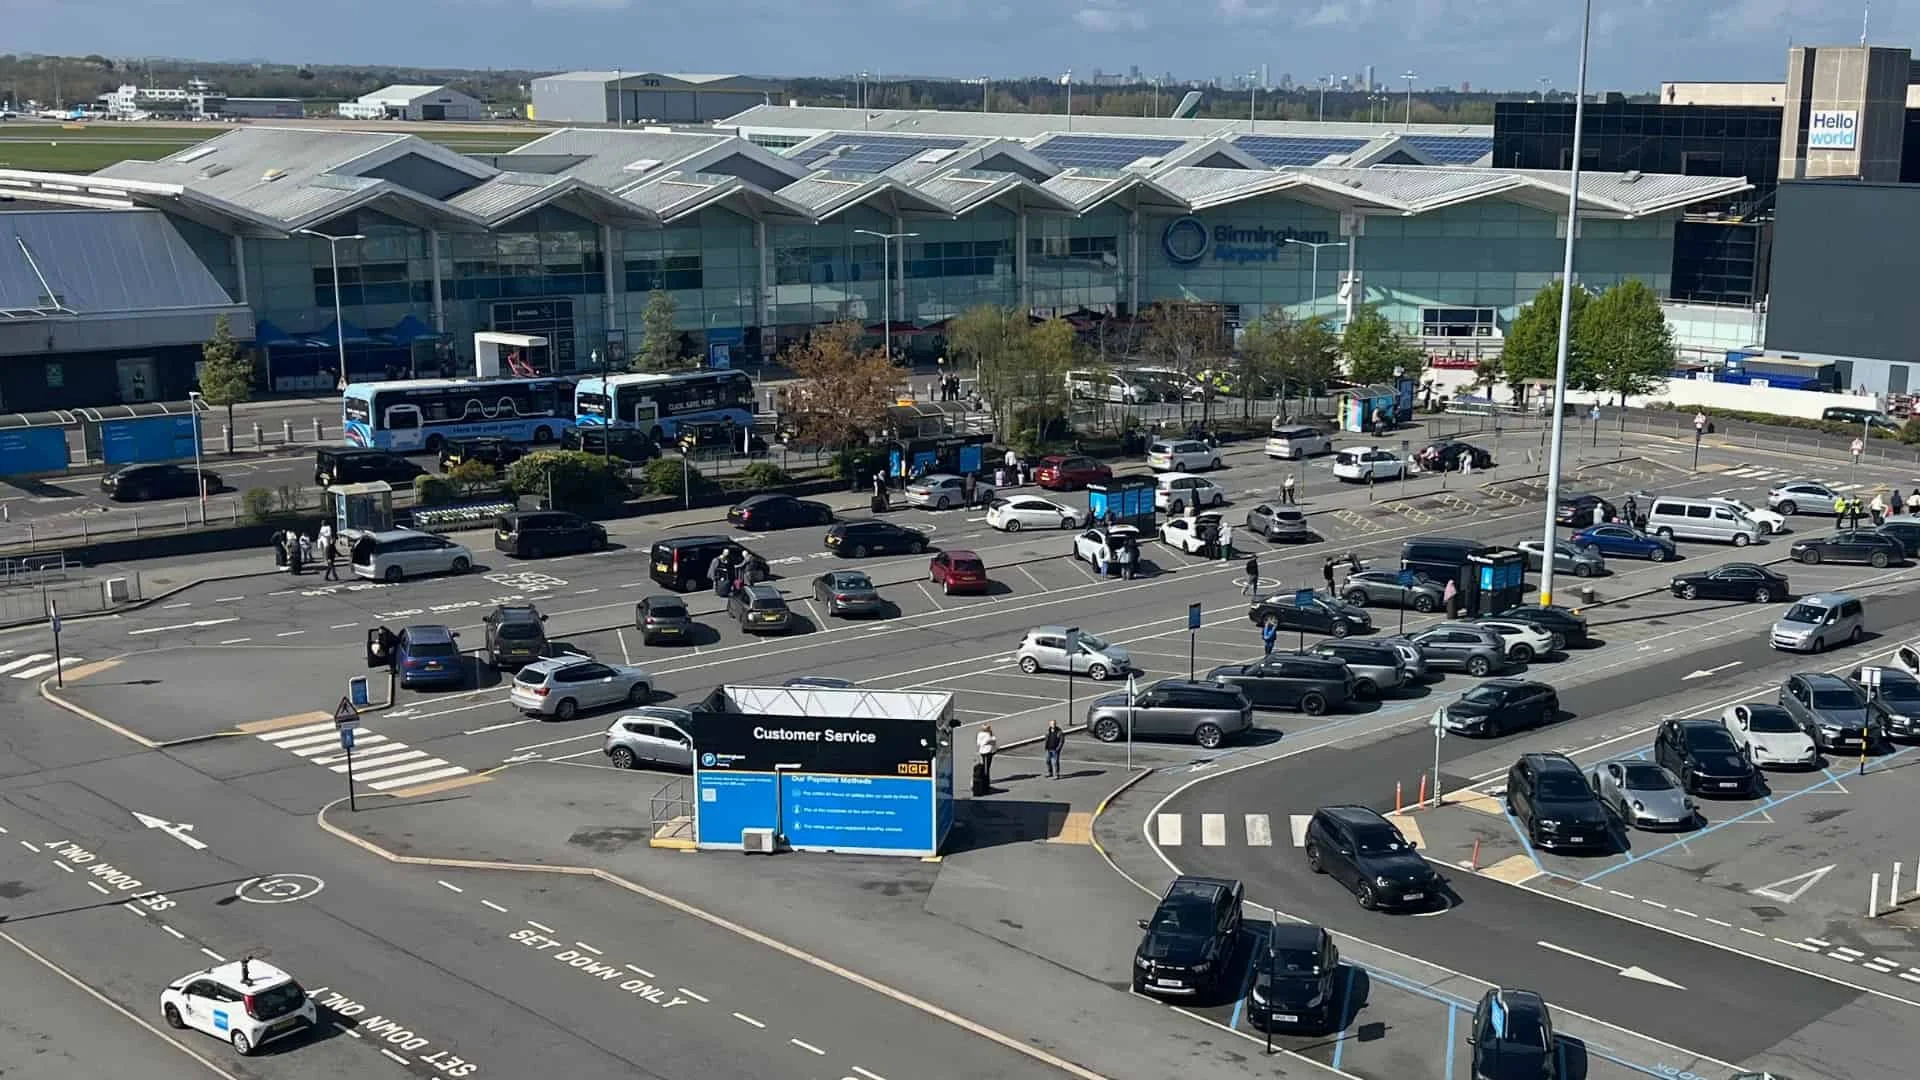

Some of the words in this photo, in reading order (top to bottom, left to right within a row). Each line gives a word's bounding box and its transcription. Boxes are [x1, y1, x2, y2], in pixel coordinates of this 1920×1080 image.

[1814, 112, 1853, 128] Hello
[1812, 130, 1854, 144] world
[1214, 225, 1329, 247] Birmingham
[1214, 245, 1280, 264] Airport
[753, 726, 822, 742] Customer
[824, 728, 877, 743] Service
[897, 763, 929, 775] NCP
[44, 839, 97, 864] ONLY
[87, 863, 143, 890] DOWN
[131, 890, 177, 911] SET
[508, 929, 561, 950] SET
[553, 950, 623, 980] DOWN
[619, 979, 688, 1008] ONLY
[305, 987, 366, 1016] ONLY
[359, 1015, 429, 1050] DOWN
[420, 1051, 478, 1077] SET
